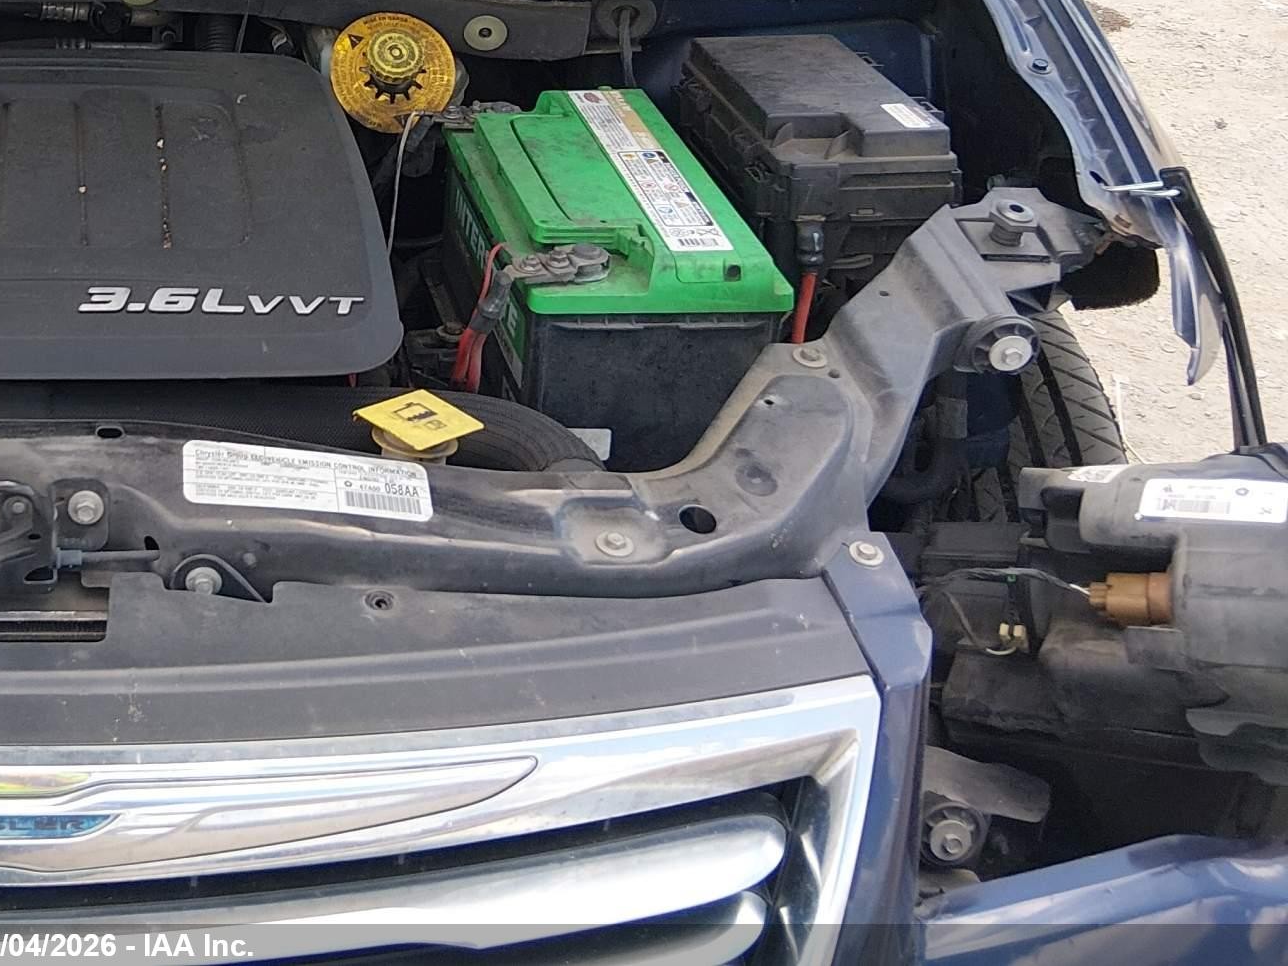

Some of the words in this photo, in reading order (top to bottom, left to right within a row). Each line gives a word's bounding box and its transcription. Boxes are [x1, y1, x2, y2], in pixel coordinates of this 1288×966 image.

[266, 454, 296, 465] VEHICLE
[298, 458, 332, 469] EMISSION
[334, 461, 367, 474] CONTROL
[369, 466, 417, 480] INFORMATION
[384, 482, 420, 498] 058AA
